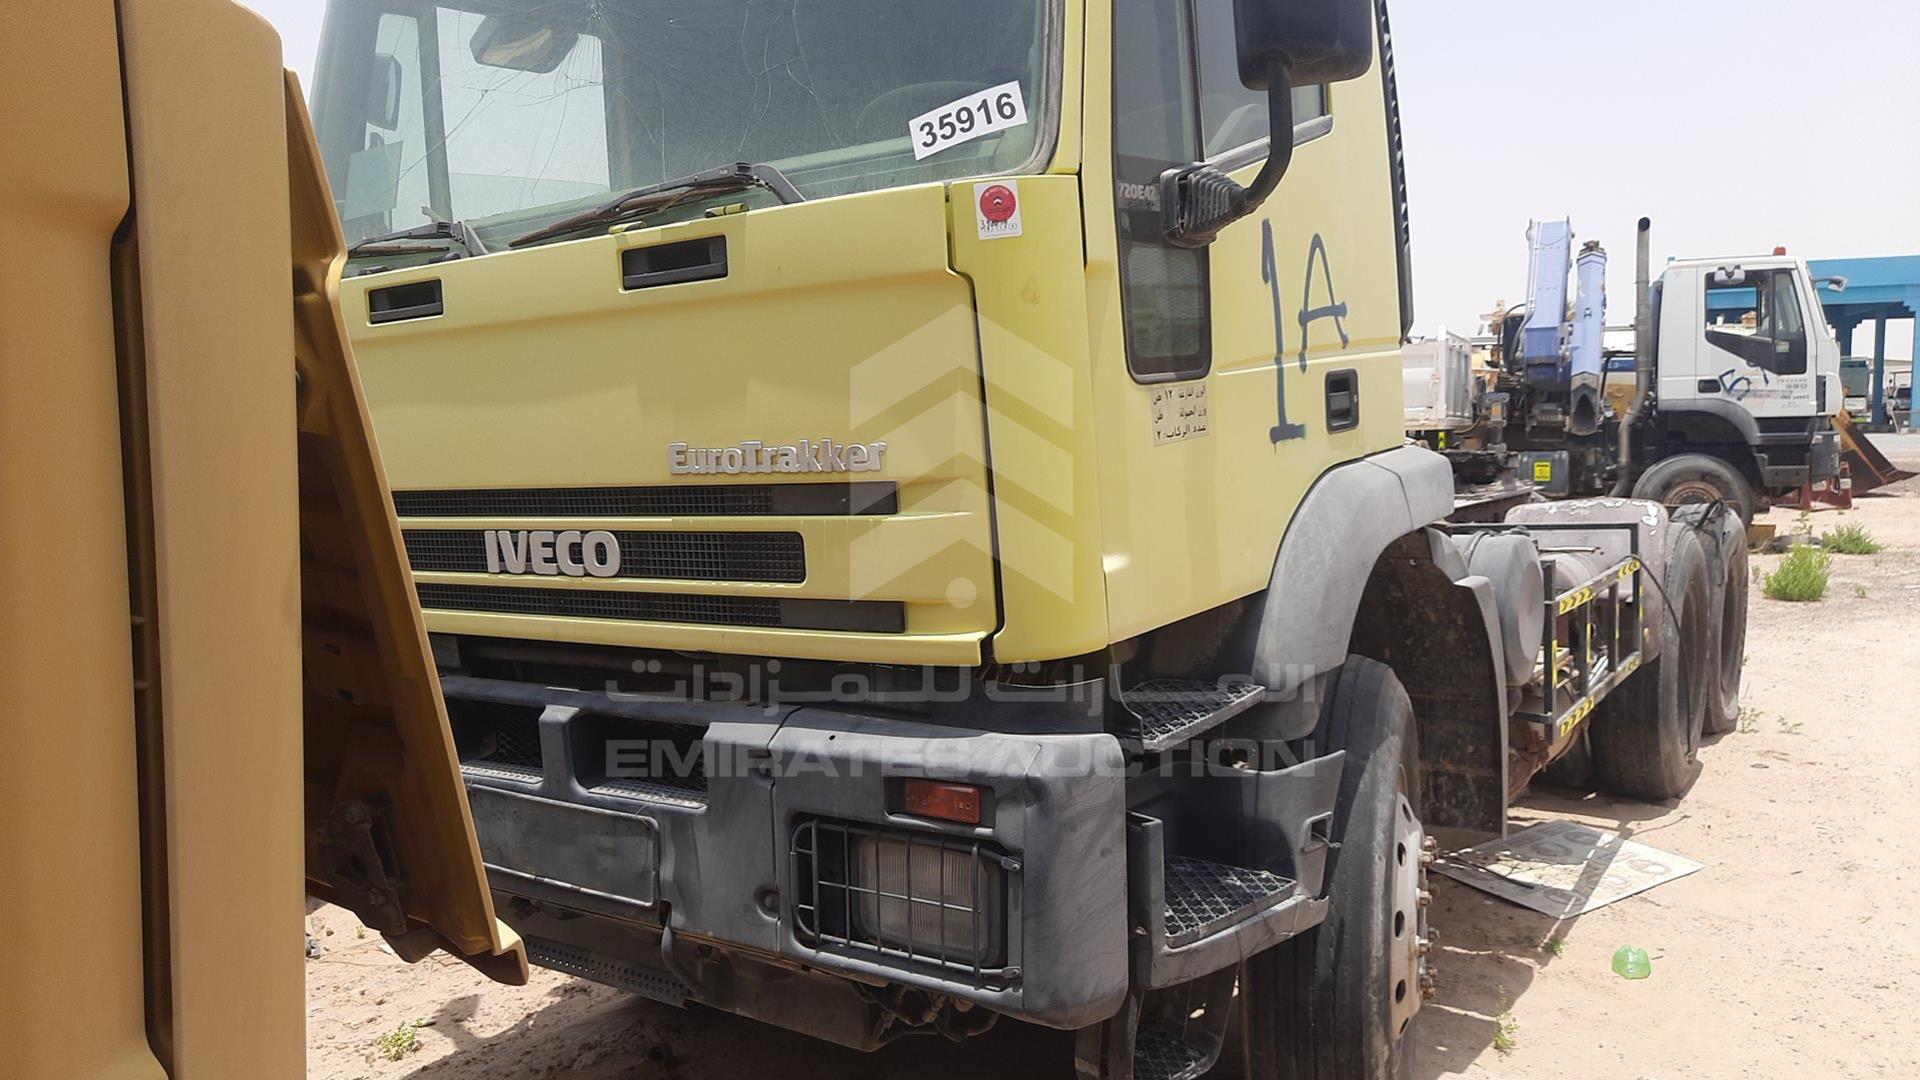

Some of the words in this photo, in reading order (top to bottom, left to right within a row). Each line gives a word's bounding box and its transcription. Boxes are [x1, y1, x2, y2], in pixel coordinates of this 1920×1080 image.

[918, 92, 1017, 148] 35916
[667, 438, 888, 475] EuroTrakker
[484, 530, 622, 577] IVECO
